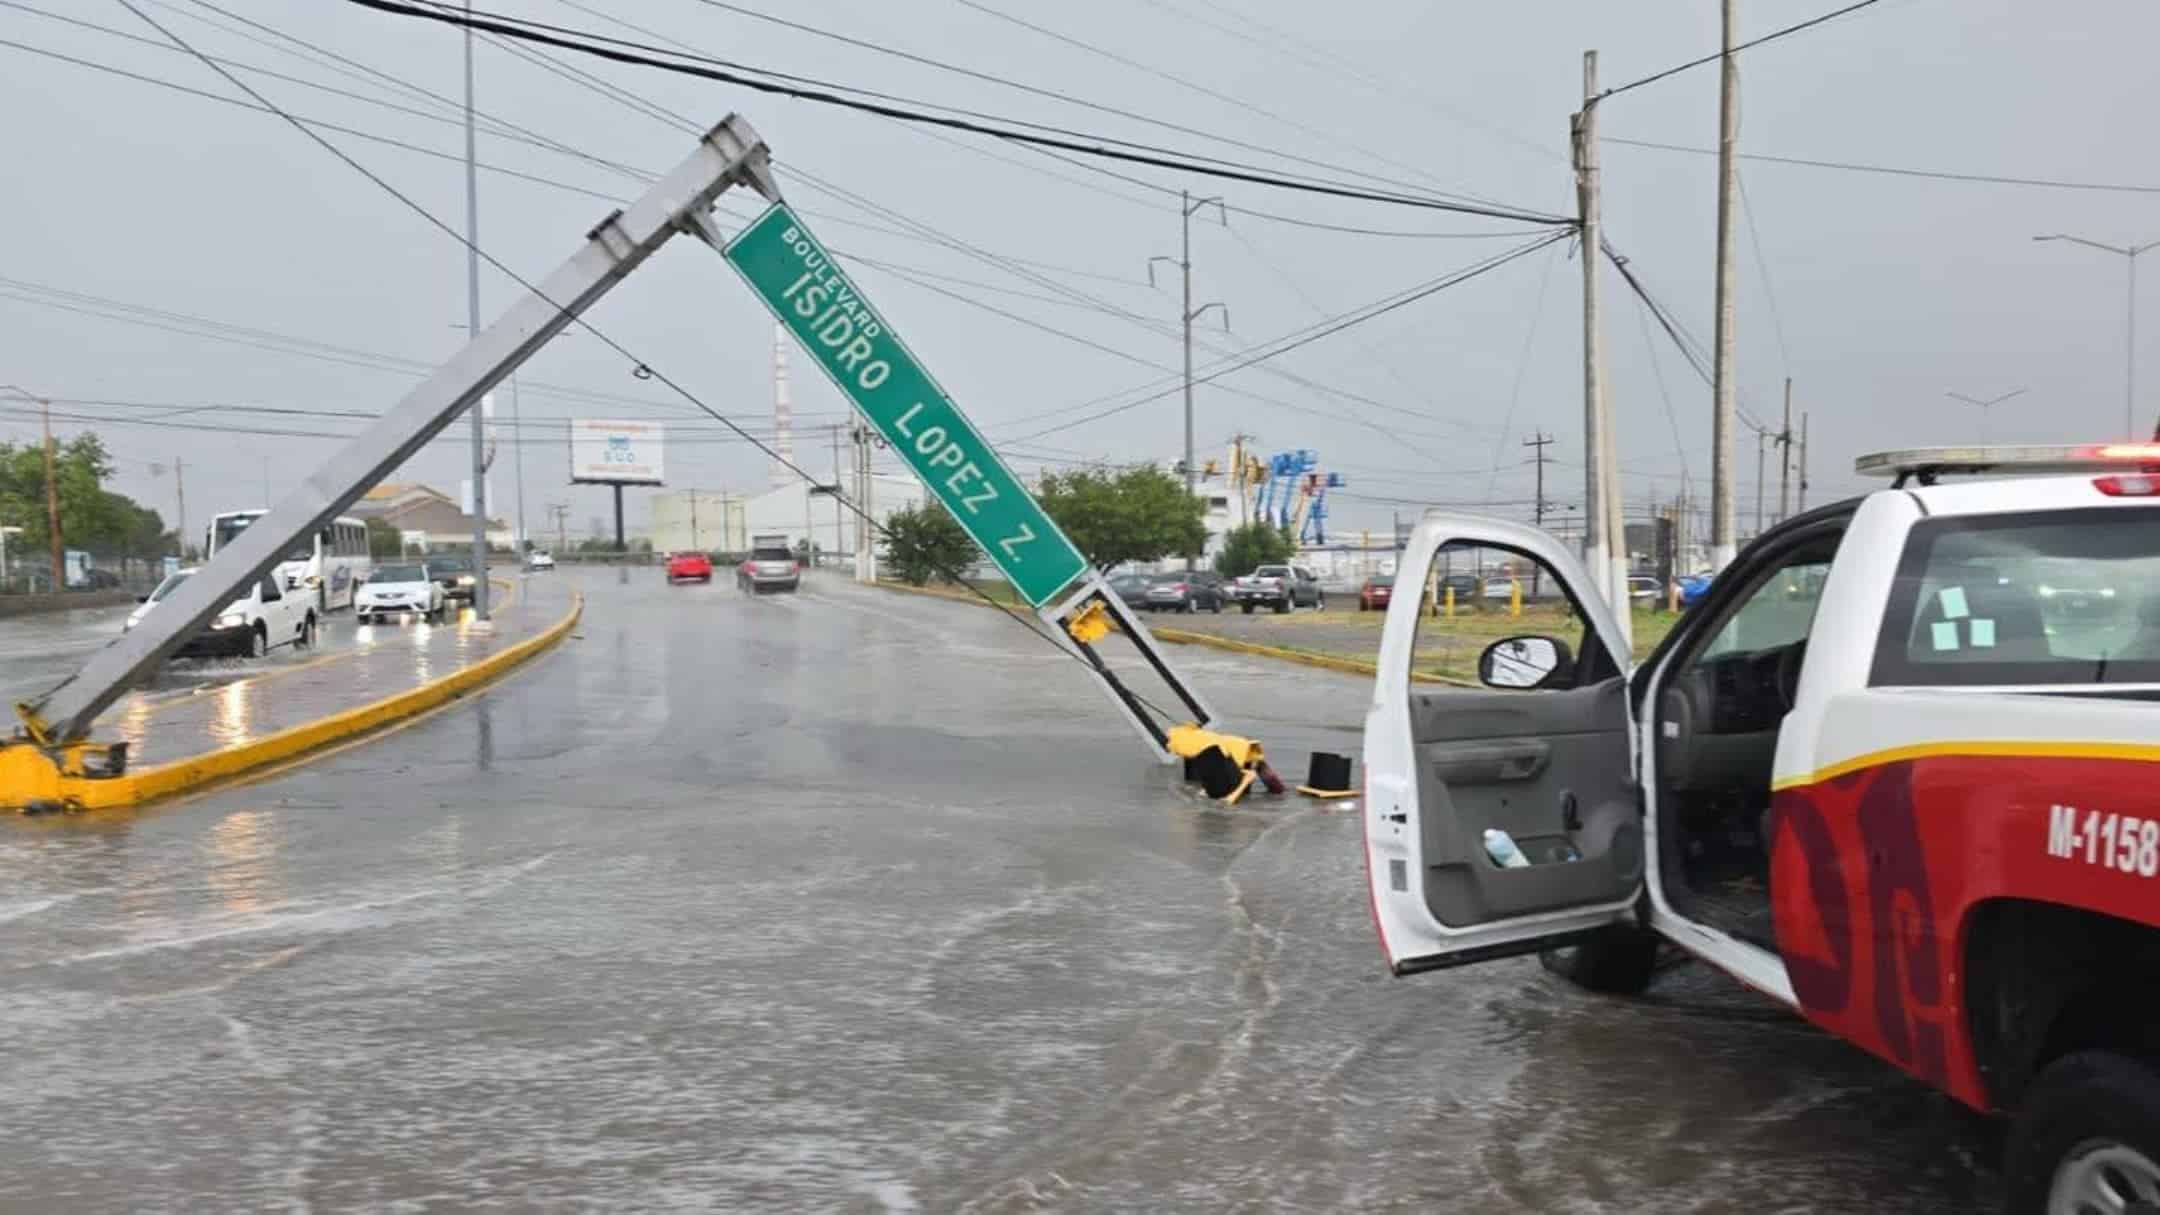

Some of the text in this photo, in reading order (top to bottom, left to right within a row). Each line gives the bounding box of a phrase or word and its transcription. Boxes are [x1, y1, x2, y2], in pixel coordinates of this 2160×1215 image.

[782, 226, 881, 338] BOULEVARD
[783, 272, 1037, 564] ISIDRO LOPEZ Z.
[2047, 804, 2160, 878] M-1158
